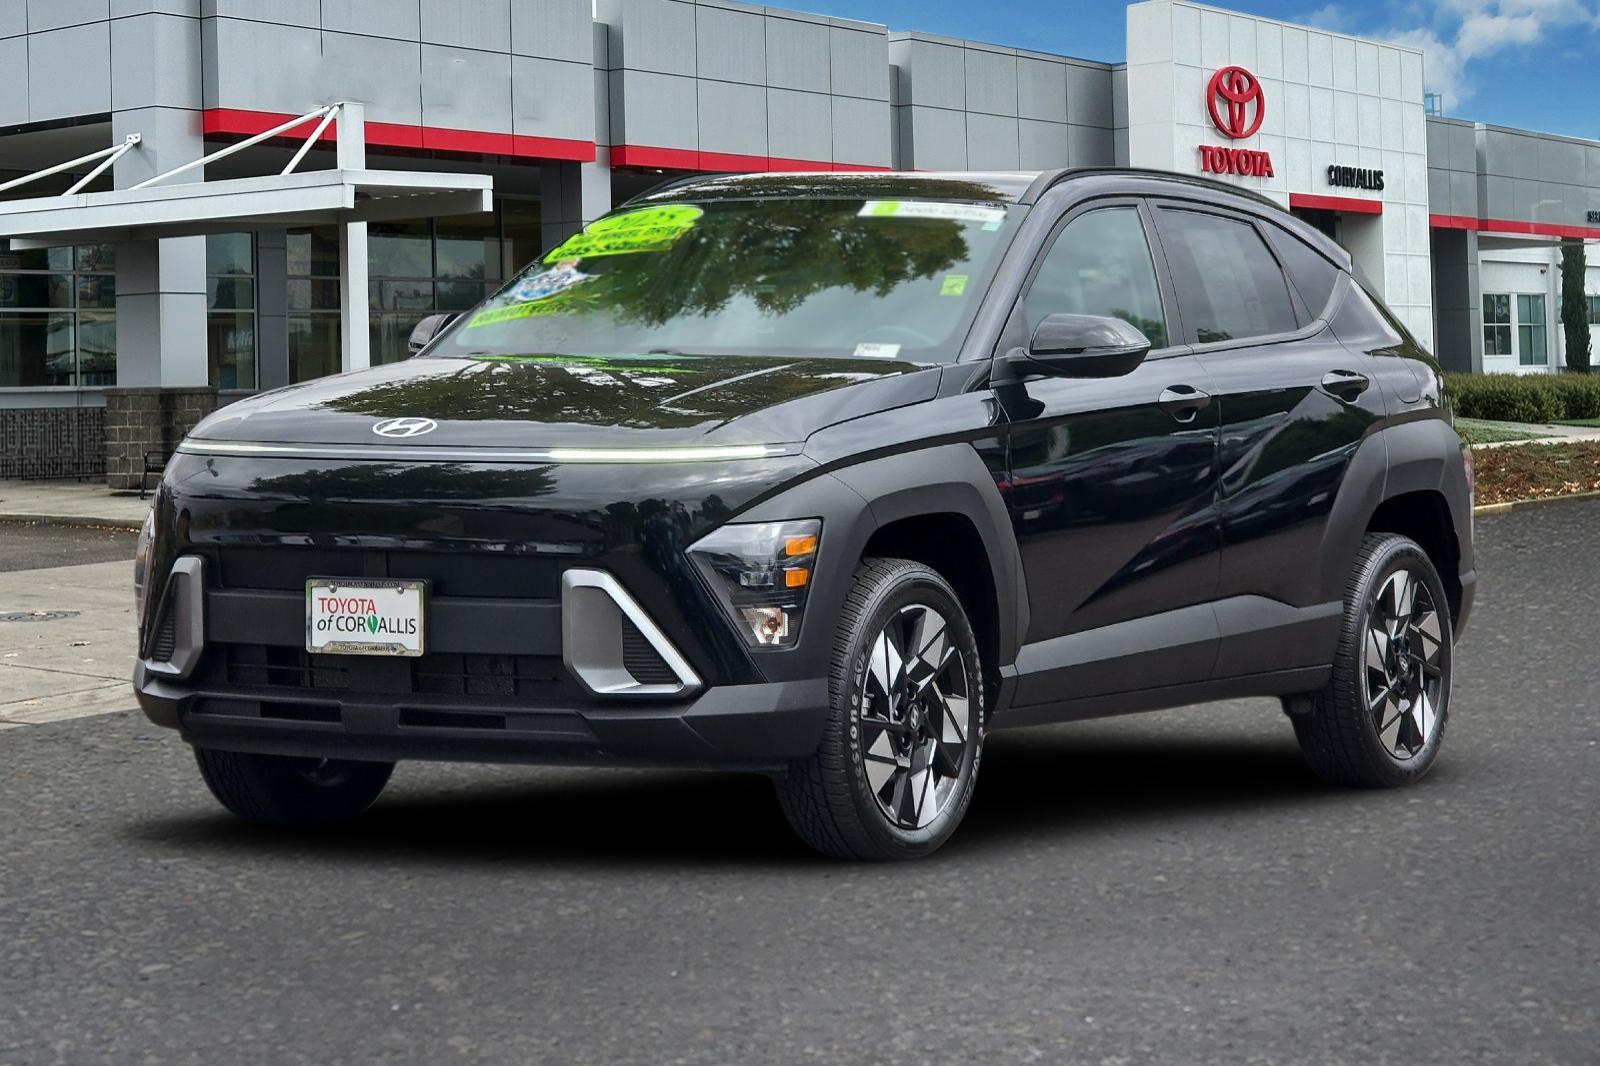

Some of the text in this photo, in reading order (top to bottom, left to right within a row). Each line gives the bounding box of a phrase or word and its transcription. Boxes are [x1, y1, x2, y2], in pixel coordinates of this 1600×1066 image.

[1198, 145, 1274, 178] TOYOTA
[1328, 165, 1385, 191] CORVALLIS
[318, 597, 377, 615] TOYOTA
[317, 614, 416, 635] of CORVALLIS
